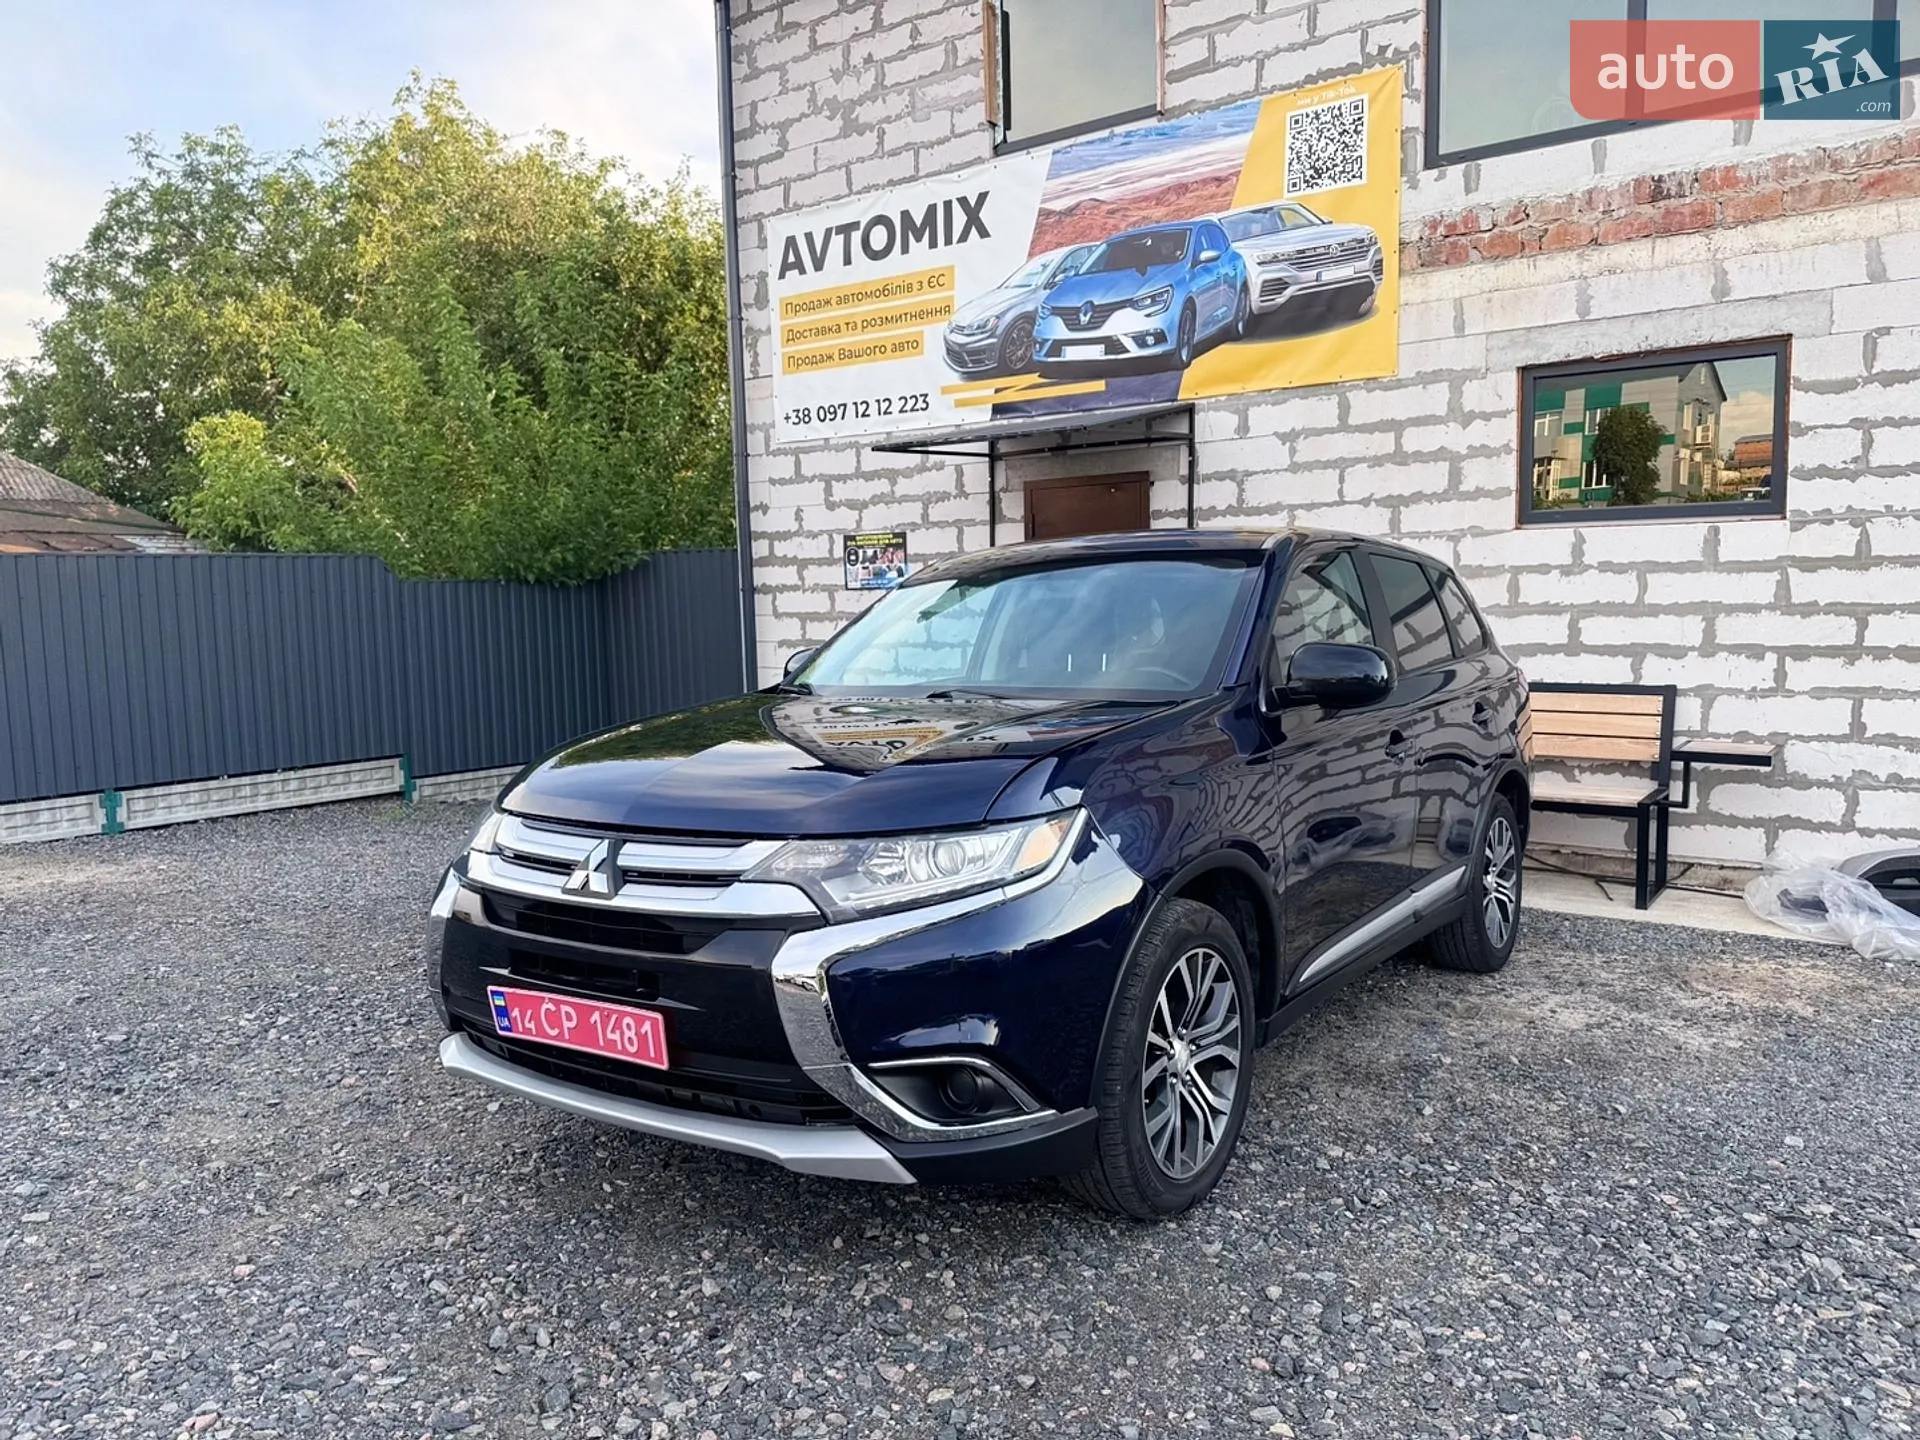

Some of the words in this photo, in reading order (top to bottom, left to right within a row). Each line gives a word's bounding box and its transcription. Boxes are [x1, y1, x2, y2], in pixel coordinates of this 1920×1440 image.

[777, 190, 992, 280] AVTOMIX
[785, 296, 833, 317] Продаж
[835, 280, 913, 304] автомобілів
[916, 279, 924, 291] з
[927, 273, 946, 289] ЄС
[785, 323, 841, 343] Доставка
[845, 321, 858, 332] та
[861, 304, 951, 333] розмитнення
[787, 351, 835, 370] Продаж
[838, 343, 887, 357] Вашого
[890, 338, 920, 354] авто
[784, 406, 812, 426] +38
[816, 402, 848, 423] 097
[852, 399, 871, 419] 12
[875, 396, 893, 416] 12
[898, 392, 930, 413] 223
[497, 1015, 511, 1028] UA
[511, 1007, 536, 1035] 14
[589, 1010, 655, 1059] 1481
